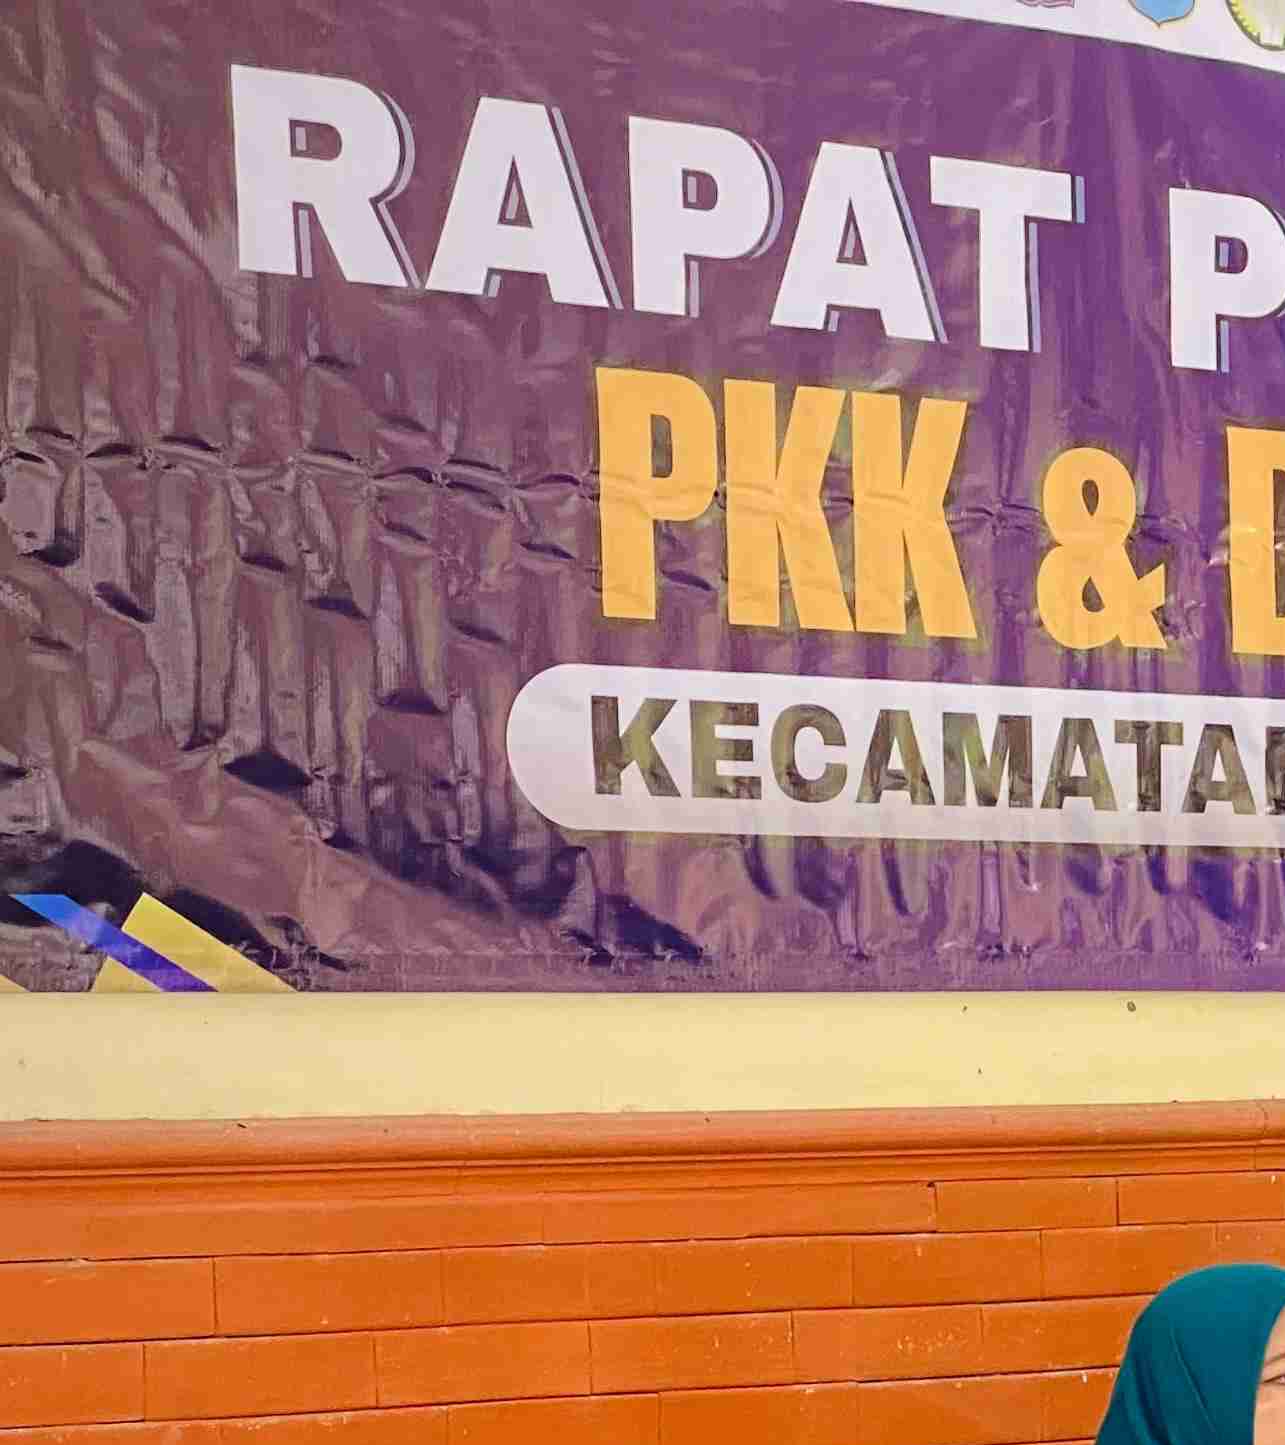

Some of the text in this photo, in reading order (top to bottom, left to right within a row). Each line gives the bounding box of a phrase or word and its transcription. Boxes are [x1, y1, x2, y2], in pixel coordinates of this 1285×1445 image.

[230, 64, 1085, 353] RAPAT
[595, 366, 979, 639] PKK
[1037, 446, 1168, 650] &
